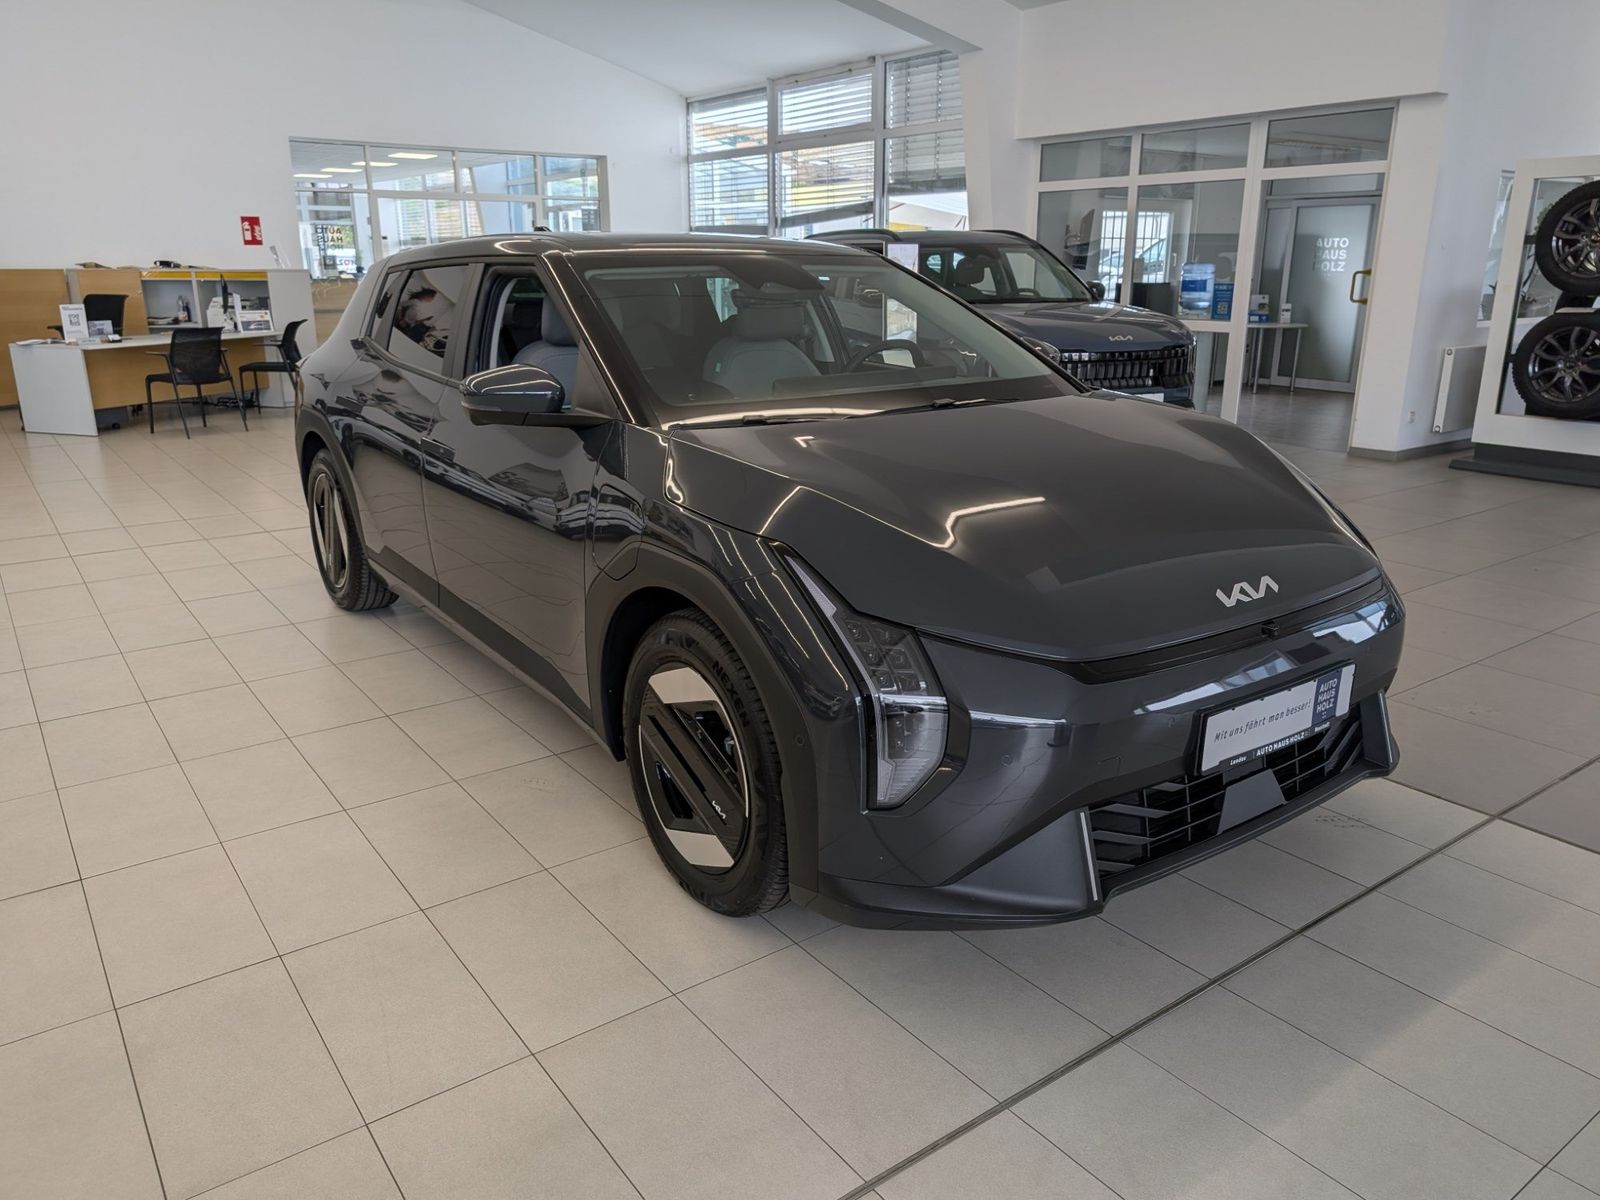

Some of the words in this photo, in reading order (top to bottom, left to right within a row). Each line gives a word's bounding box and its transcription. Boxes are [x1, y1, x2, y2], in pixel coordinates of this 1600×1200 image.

[1316, 237, 1349, 248] AUTO
[1315, 261, 1345, 271] OLZ
[1216, 575, 1279, 608] KIA
[1319, 678, 1338, 693] AUTO
[711, 660, 750, 728] NEXEN
[1318, 688, 1336, 703] HAUS
[1316, 698, 1335, 713] HOLZ
[1214, 730, 1228, 743] Mit
[1229, 725, 1244, 737] uns
[1244, 717, 1266, 734] fährt
[1268, 711, 1285, 723] man
[1286, 698, 1312, 717] besser!
[1256, 745, 1273, 757] AUTO
[1273, 738, 1290, 750] HAUS
[1289, 731, 1305, 743] HOLZ
